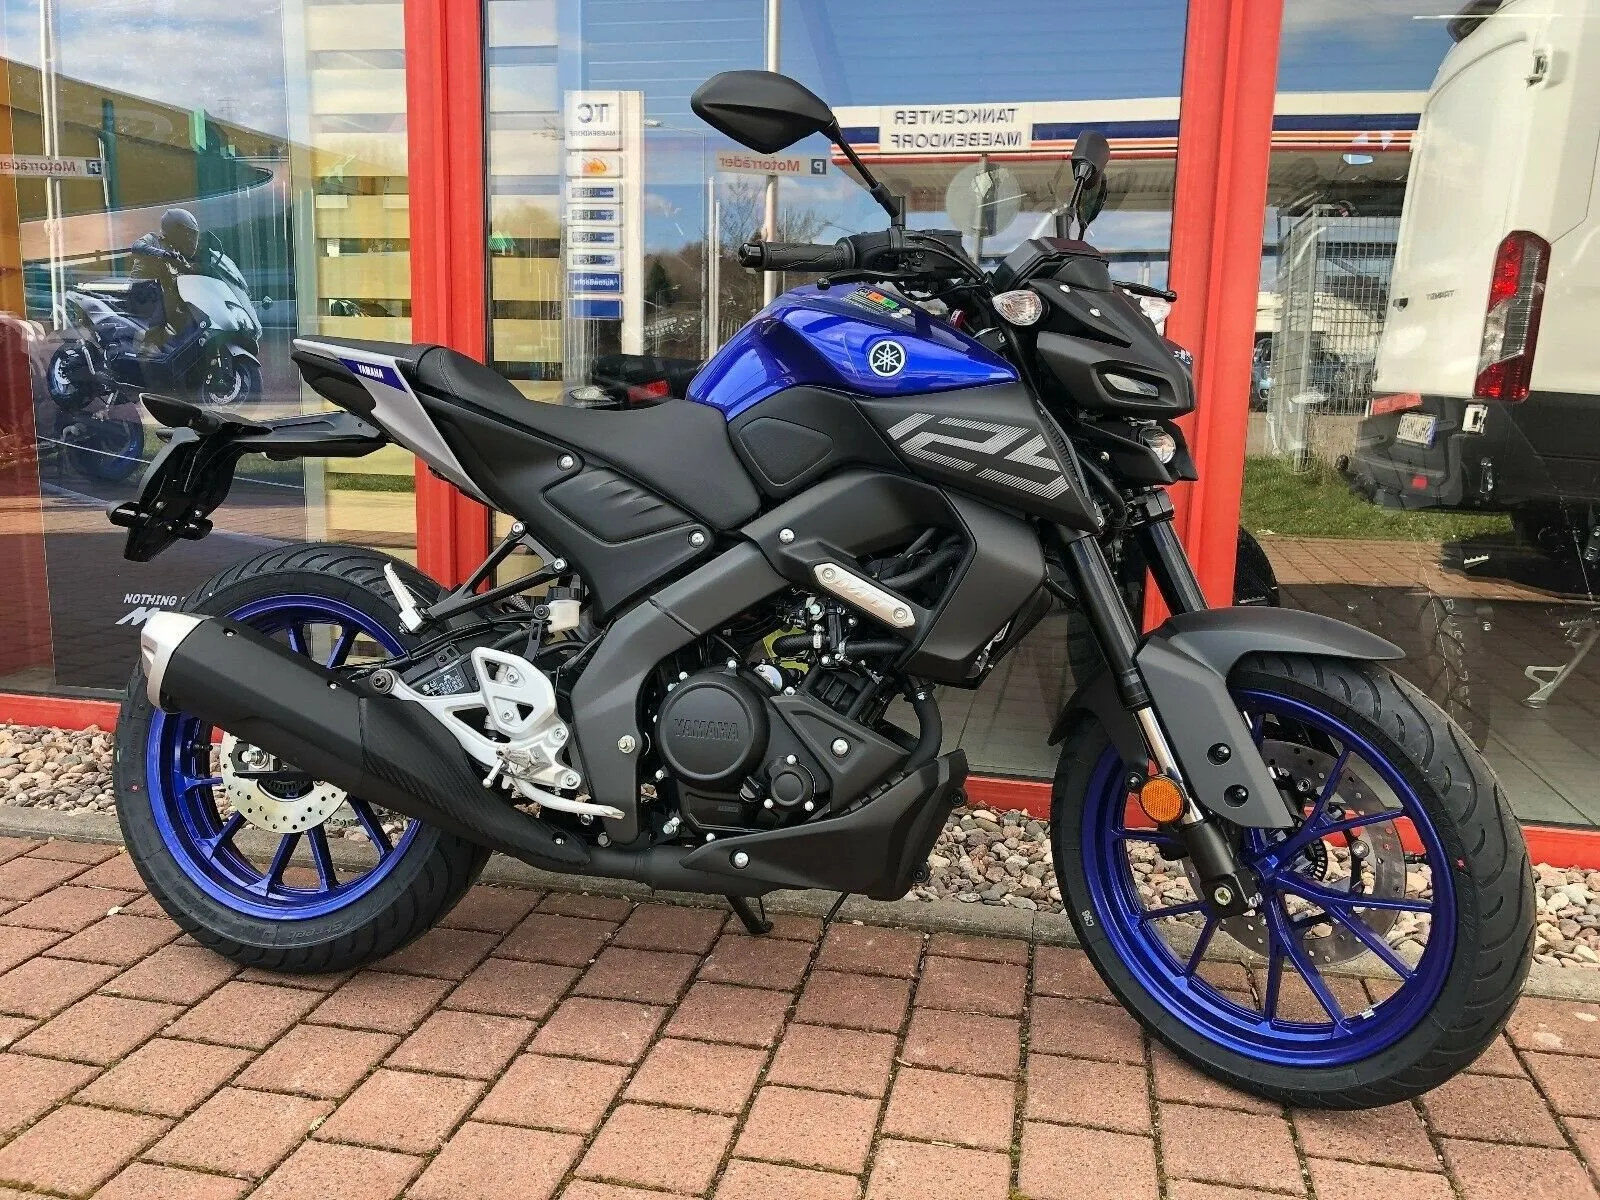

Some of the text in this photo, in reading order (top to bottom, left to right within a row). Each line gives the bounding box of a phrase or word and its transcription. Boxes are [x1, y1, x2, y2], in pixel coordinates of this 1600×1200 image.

[356, 363, 385, 379] YAMAHA
[887, 412, 1070, 500] 125
[123, 593, 178, 606] NOTHING
[674, 718, 740, 741] YAMAHA
